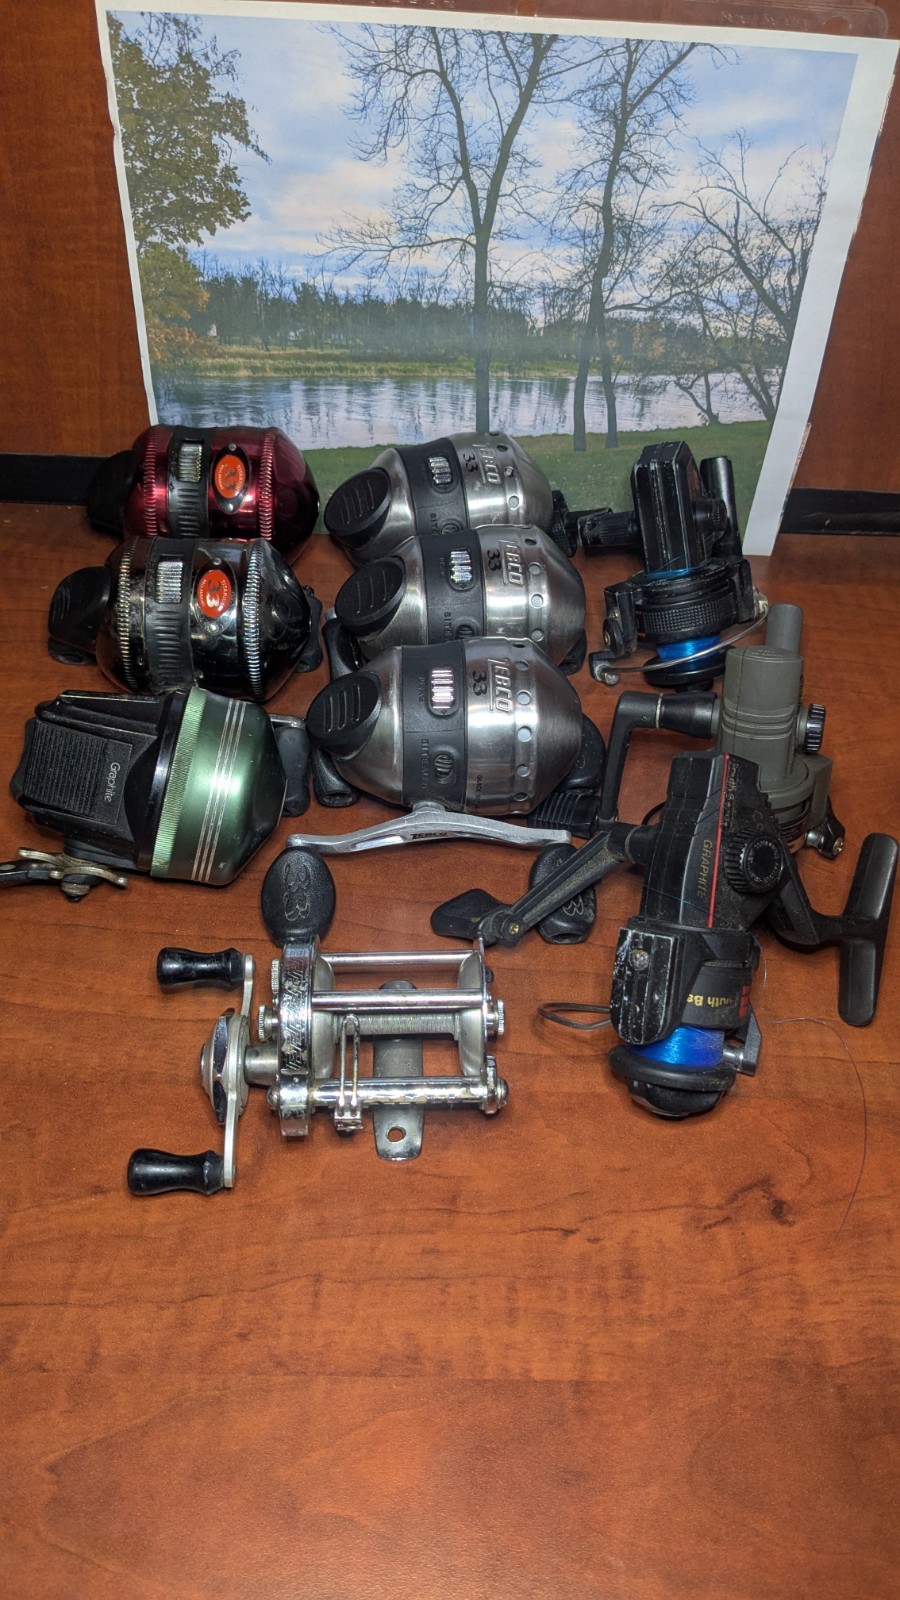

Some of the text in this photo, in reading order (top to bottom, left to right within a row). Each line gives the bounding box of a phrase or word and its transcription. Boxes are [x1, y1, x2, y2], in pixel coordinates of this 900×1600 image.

[462, 452, 478, 472] 33
[225, 464, 237, 491] 33
[487, 549, 502, 571] 33
[498, 539, 524, 586] ZEBCO
[206, 579, 221, 608] 33
[473, 670, 488, 696] 33
[487, 658, 514, 713] ZEBCO
[104, 762, 121, 803] Graphite
[697, 839, 713, 898] GRAPHITE
[707, 996, 735, 1008] outh
